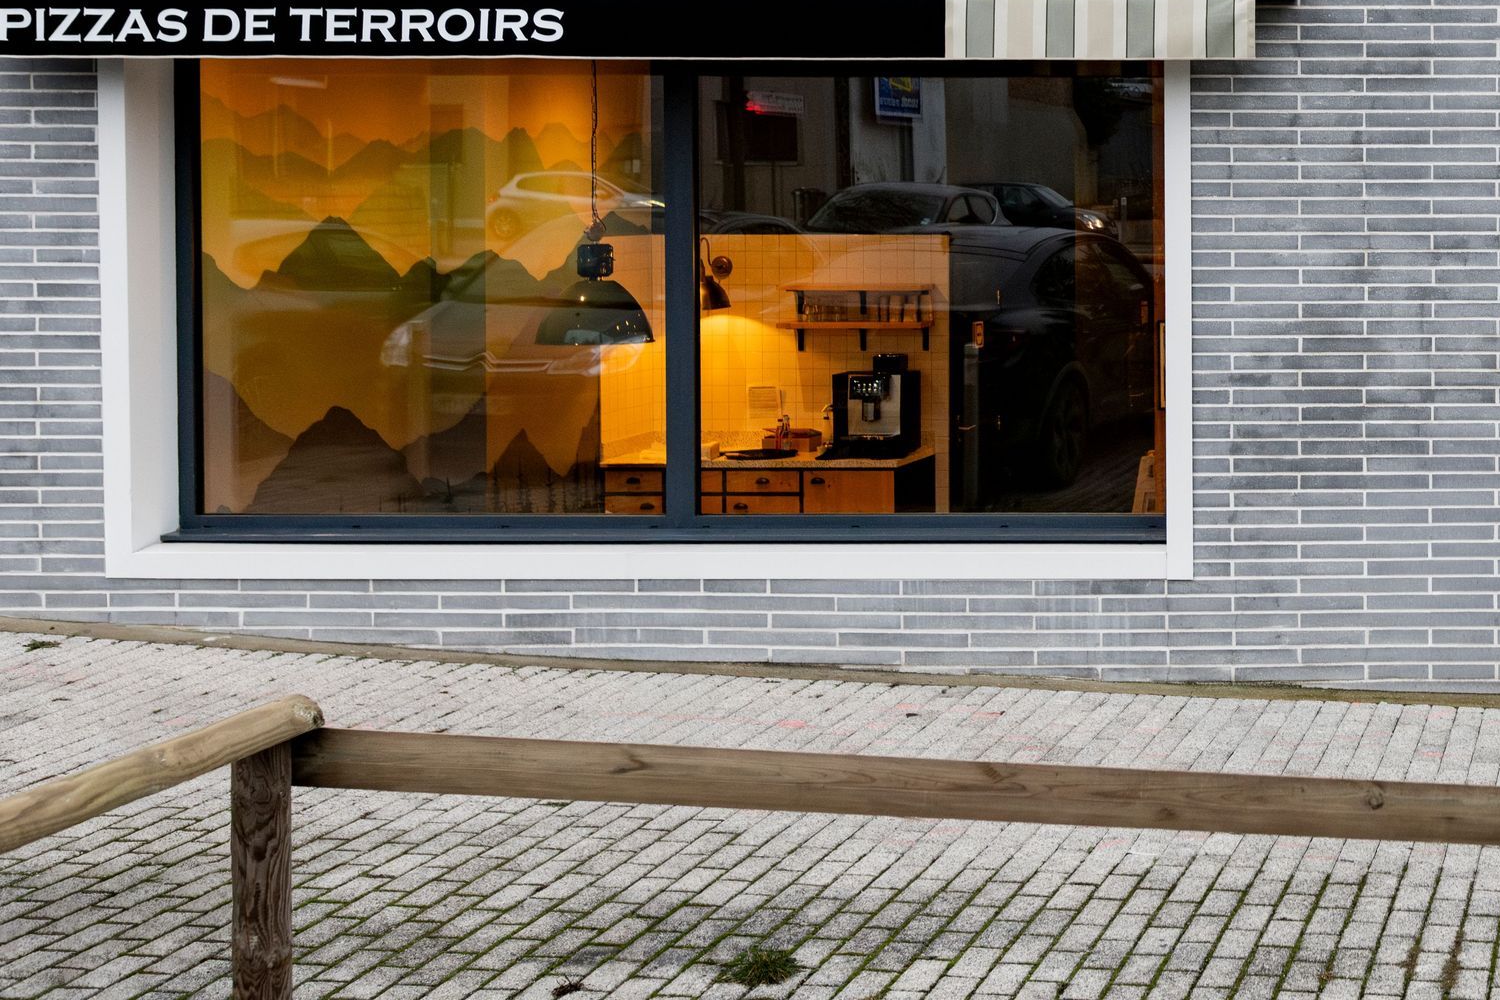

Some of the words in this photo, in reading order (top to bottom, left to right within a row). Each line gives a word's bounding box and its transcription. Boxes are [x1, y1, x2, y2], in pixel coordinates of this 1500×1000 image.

[0, 6, 188, 43] PIZZAS
[202, 7, 277, 43] DE
[289, 6, 565, 43] TERROIRS
